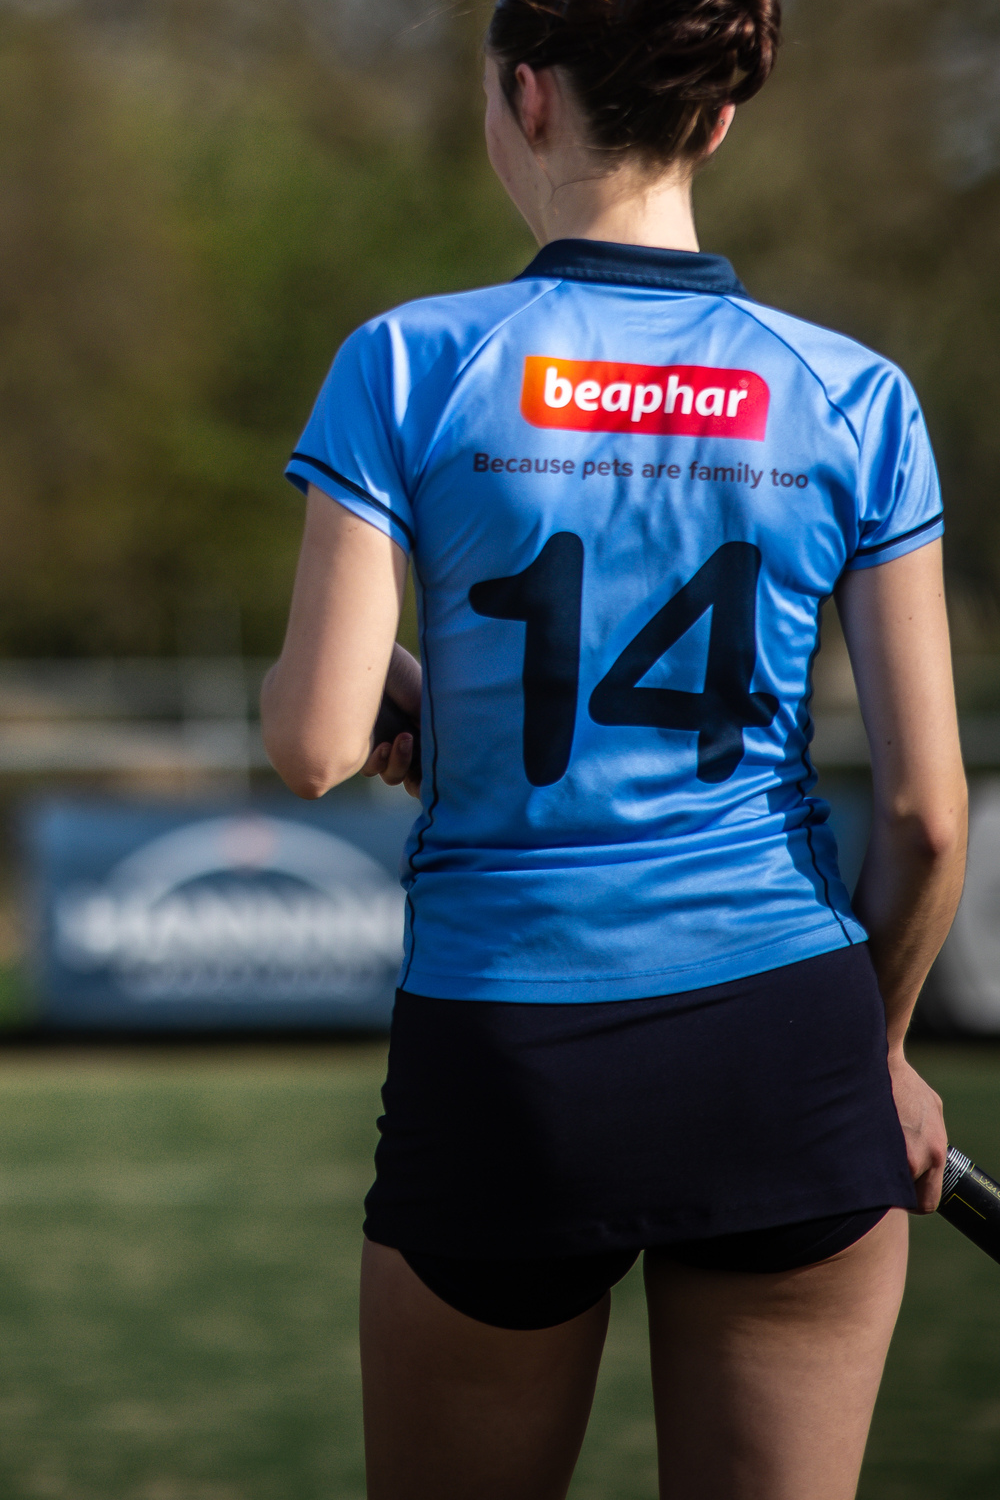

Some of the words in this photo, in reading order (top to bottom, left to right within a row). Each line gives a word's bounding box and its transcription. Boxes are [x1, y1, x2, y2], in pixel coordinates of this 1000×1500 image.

[543, 366, 749, 423] beaphar
[472, 452, 576, 475] Because
[581, 458, 634, 481] pets
[641, 462, 682, 480] are
[688, 460, 764, 490] family
[770, 467, 809, 490] too
[467, 530, 781, 788] 14
